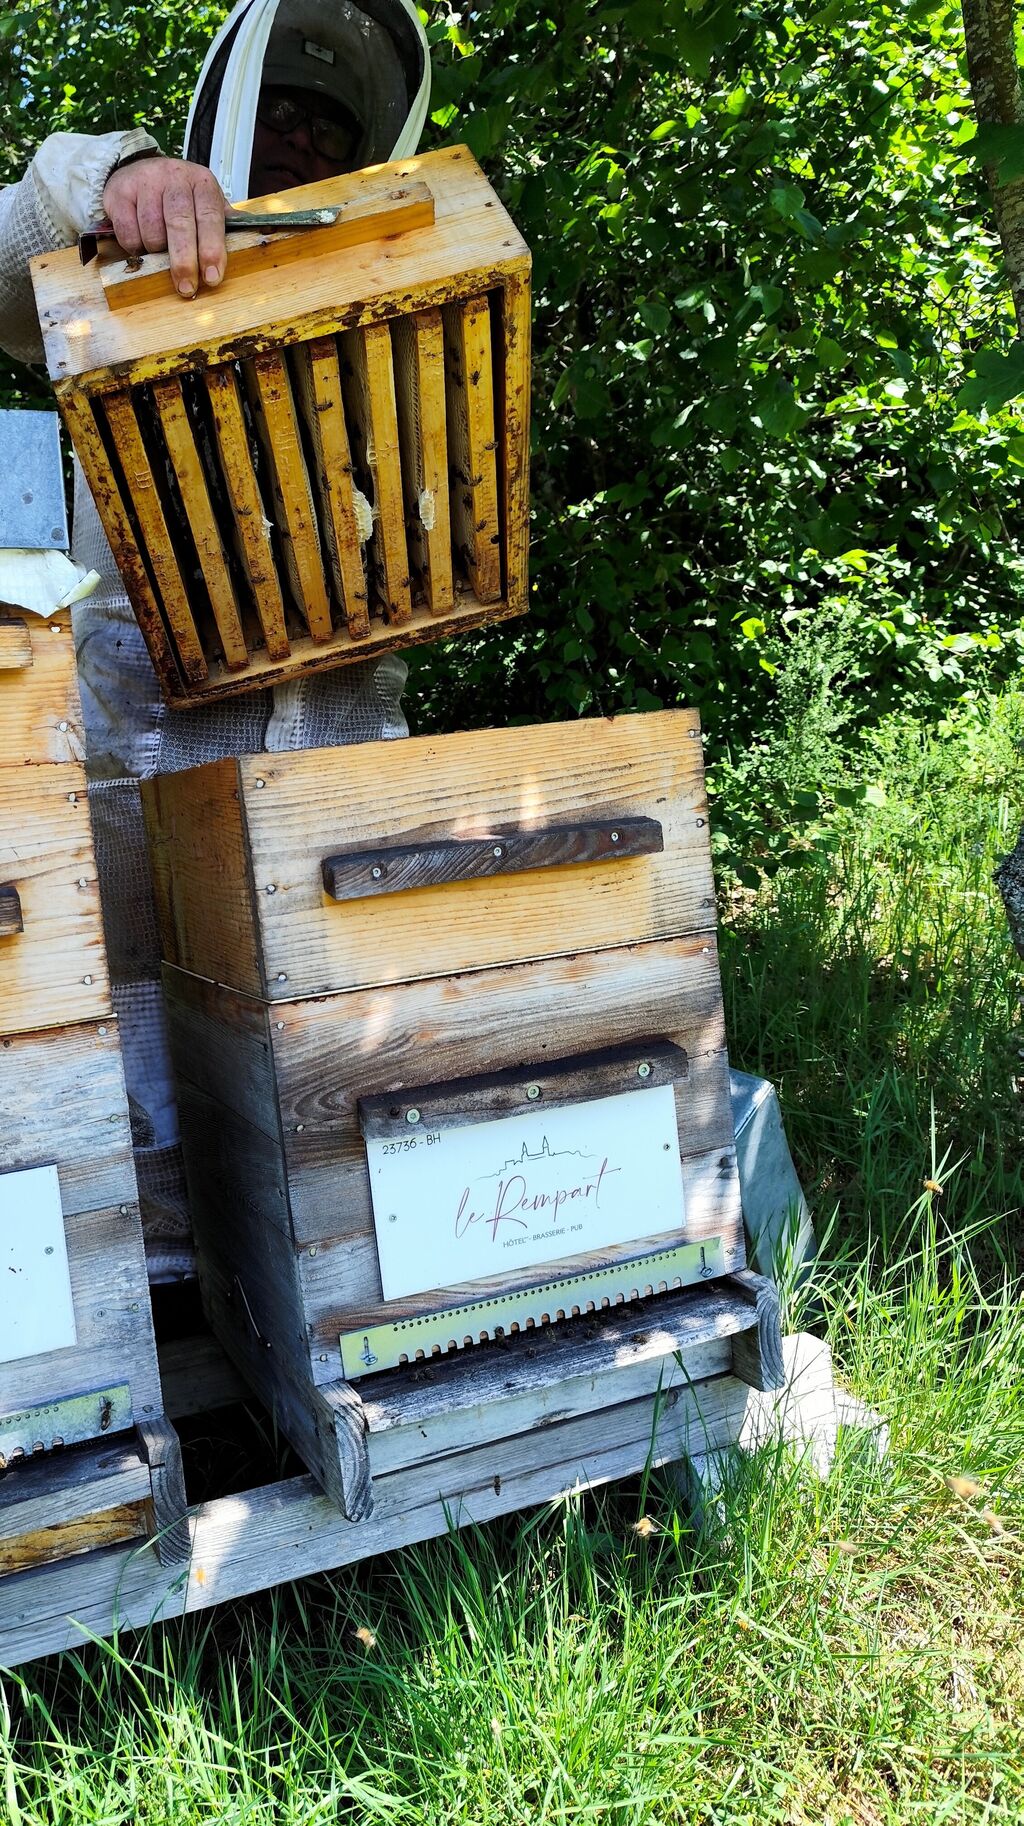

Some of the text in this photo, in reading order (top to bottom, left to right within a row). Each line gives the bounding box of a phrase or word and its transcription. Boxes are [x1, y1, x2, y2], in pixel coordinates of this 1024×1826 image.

[382, 1137, 417, 1155] 23736
[426, 1133, 441, 1146] BH
[455, 1157, 622, 1243] le Rempart
[532, 1227, 566, 1241] BRASSERIE
[570, 1223, 583, 1232] PUB
